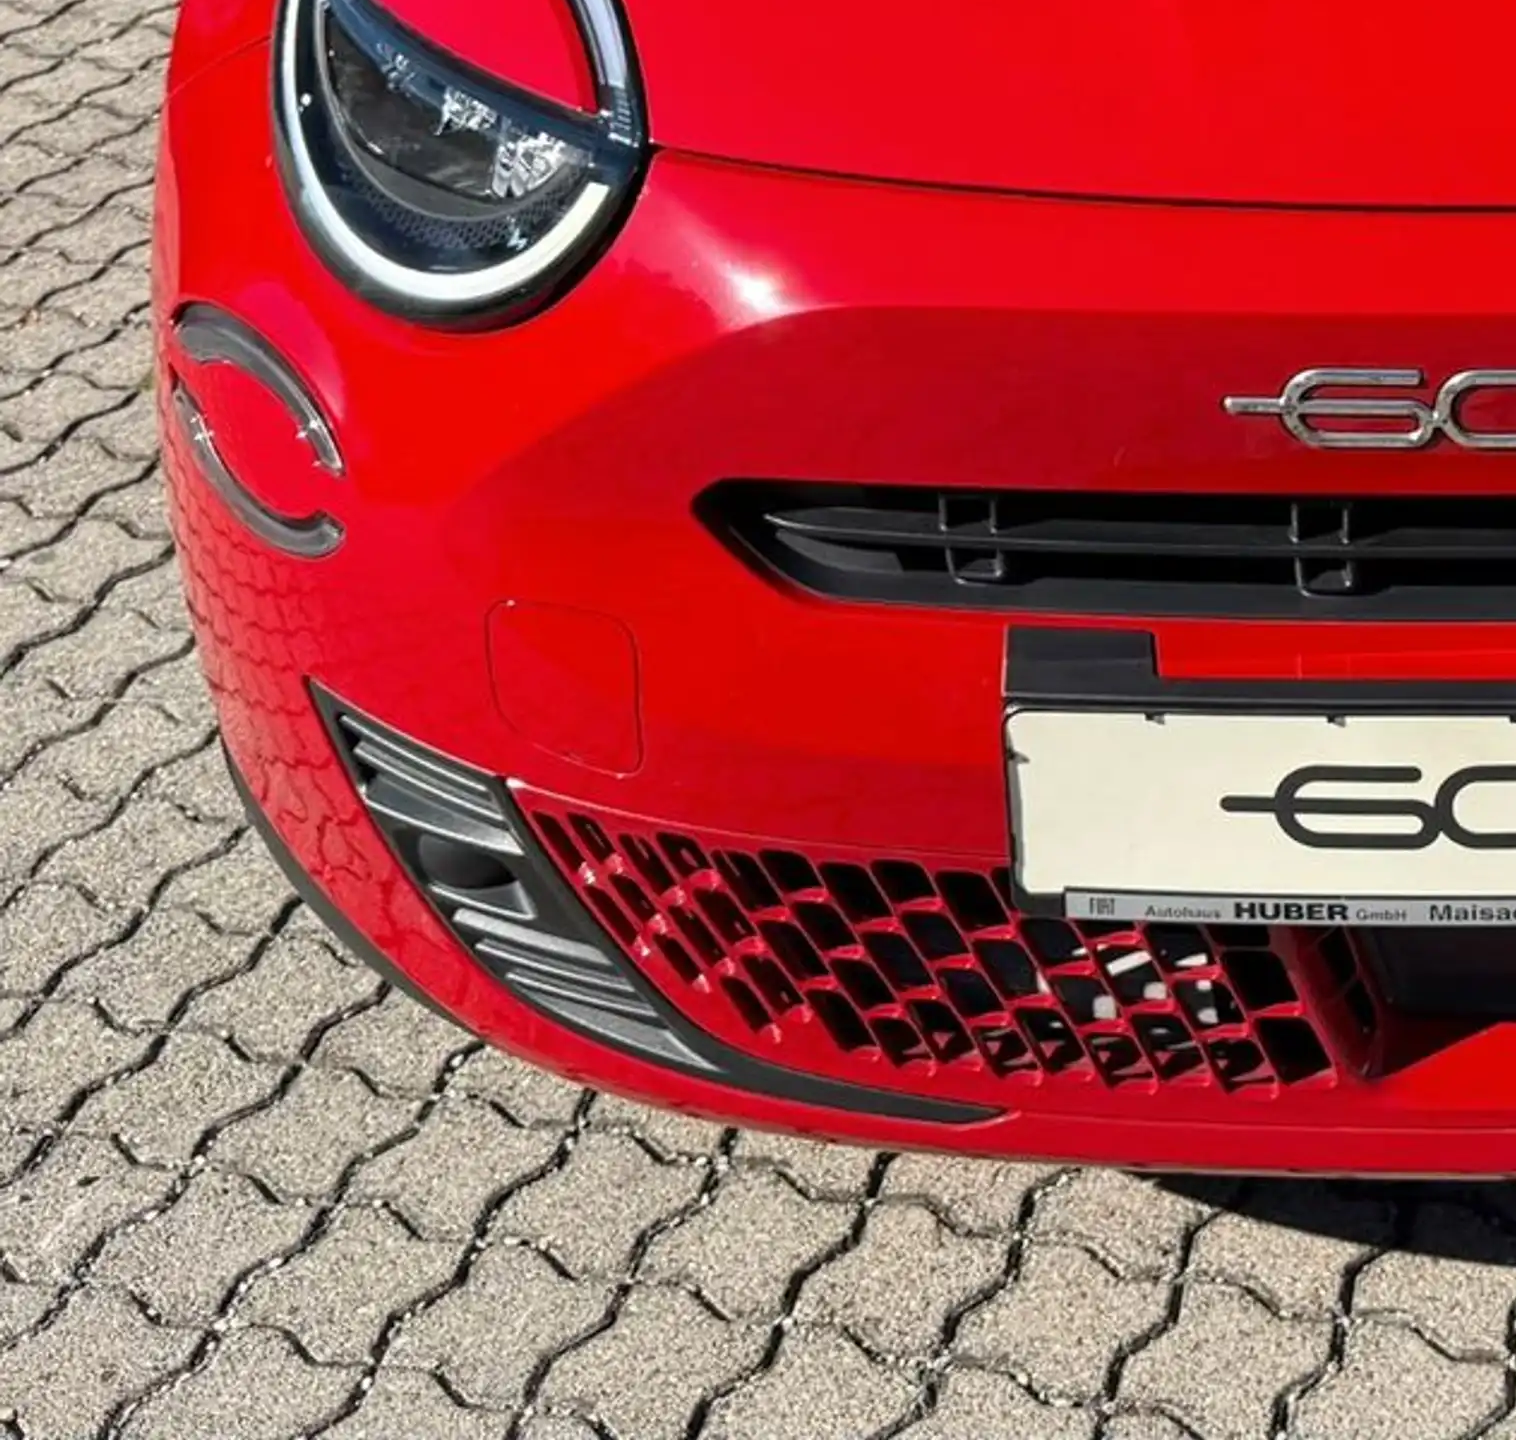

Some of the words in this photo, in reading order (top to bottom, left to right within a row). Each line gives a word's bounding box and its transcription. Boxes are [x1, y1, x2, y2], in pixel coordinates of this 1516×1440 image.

[1145, 903, 1222, 920] Autohaus
[1234, 901, 1350, 922] HUBER
[1356, 907, 1408, 921] GmbH
